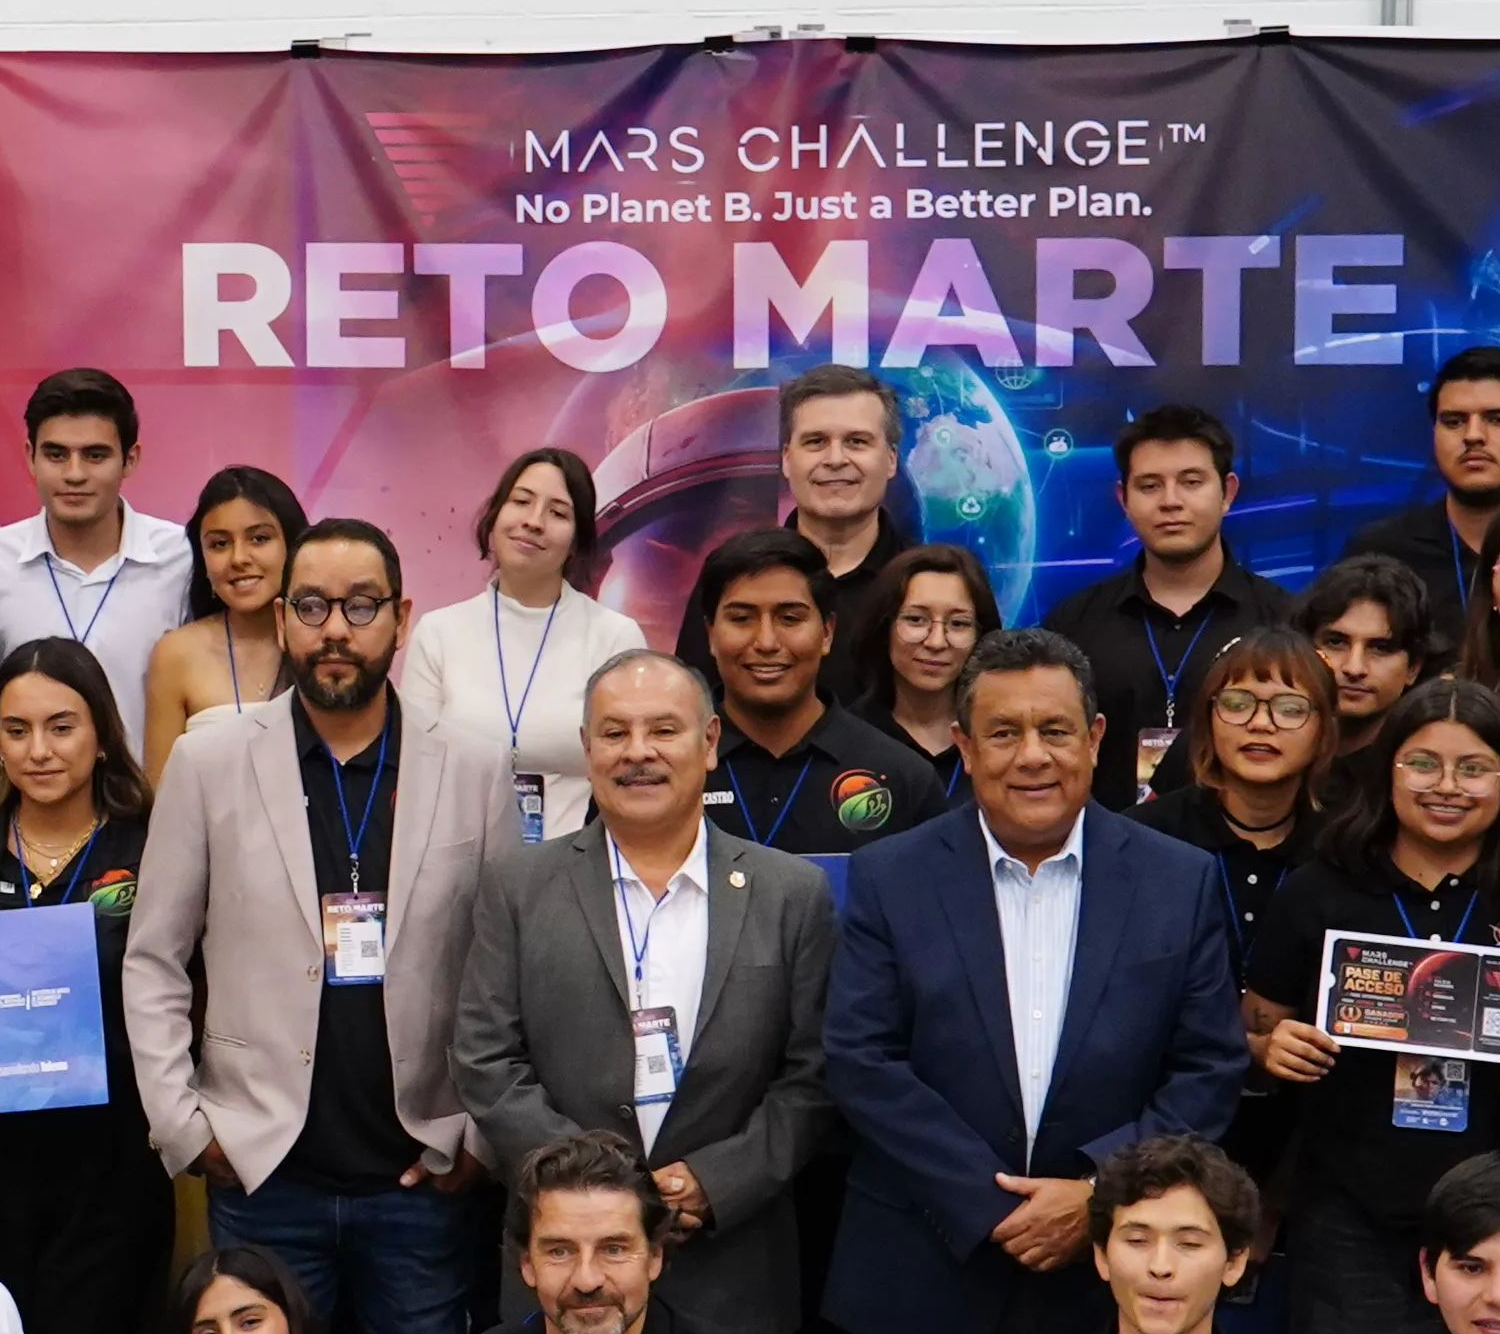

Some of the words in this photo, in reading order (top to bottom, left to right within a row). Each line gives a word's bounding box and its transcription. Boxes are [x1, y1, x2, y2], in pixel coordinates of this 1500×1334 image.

[524, 126, 705, 173] MARS
[515, 194, 570, 223] No
[582, 191, 711, 223] Planet
[725, 191, 762, 222] B.
[774, 190, 855, 221] Just
[869, 197, 893, 220] a
[906, 187, 1036, 219] Better
[1050, 185, 1153, 217] Plan.
[182, 241, 667, 372] RETO
[733, 234, 1404, 368] MARTE
[702, 790, 734, 805] CASTRO
[327, 904, 350, 913] RETO
[352, 903, 385, 913] MARTE
[1345, 966, 1381, 980] PASE
[1383, 971, 1402, 983] DE
[1344, 978, 1404, 996] ACCESO
[638, 1018, 670, 1030] MARTE
